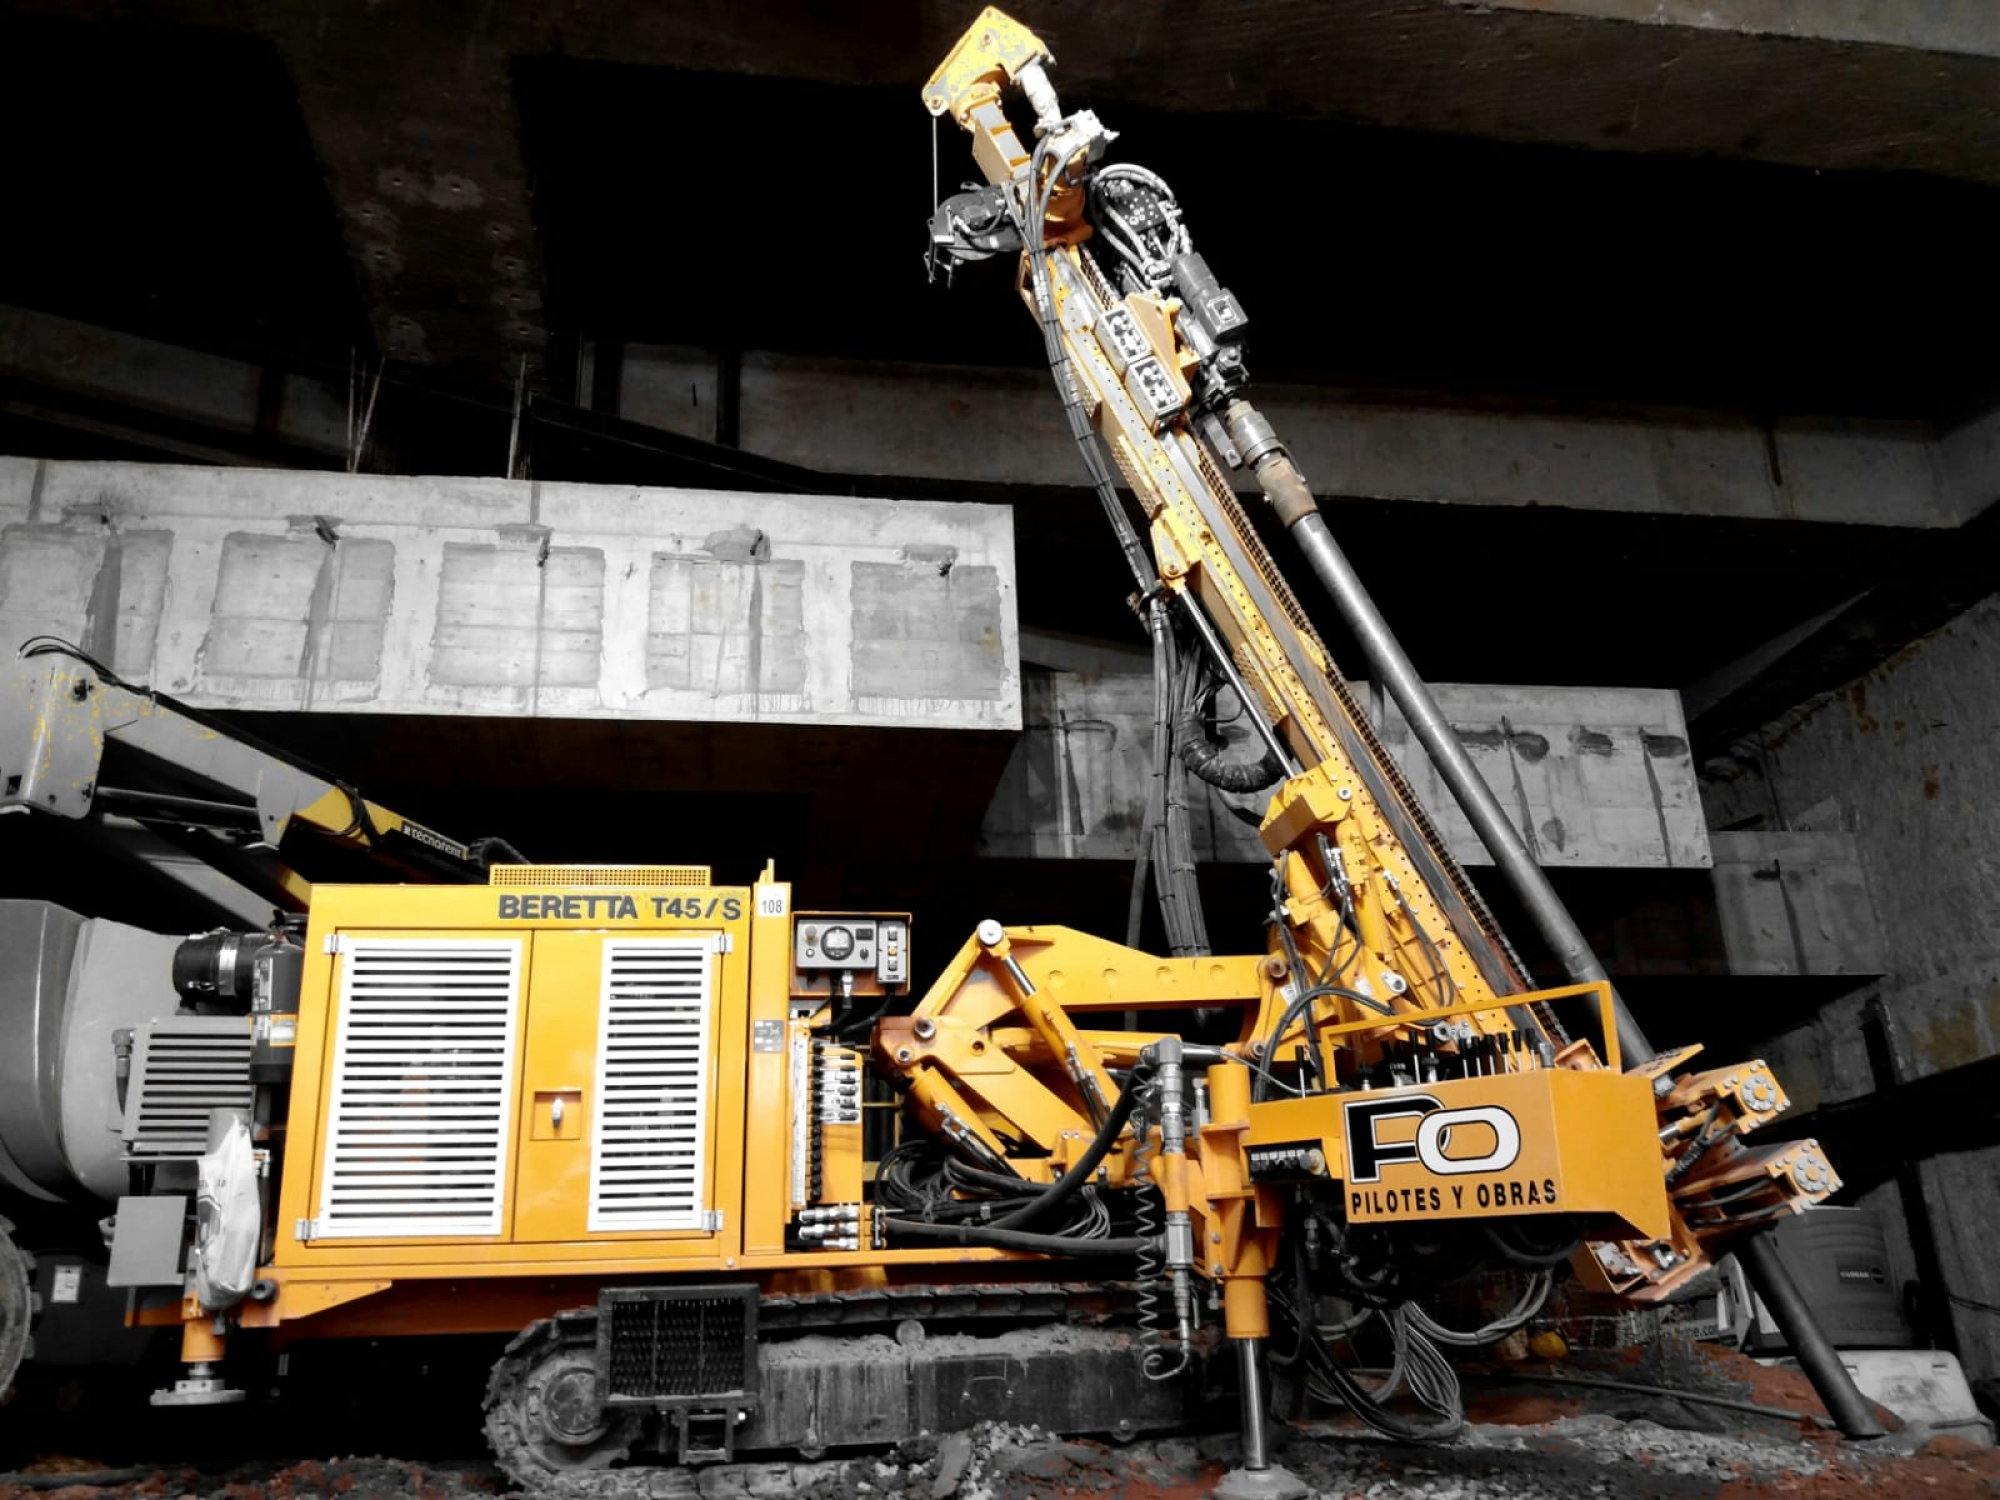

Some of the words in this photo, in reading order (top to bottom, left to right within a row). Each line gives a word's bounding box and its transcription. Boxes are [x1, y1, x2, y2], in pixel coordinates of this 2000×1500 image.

[498, 894, 639, 920] BERETTA
[650, 897, 741, 921] T45/S
[761, 899, 783, 914] 108
[1343, 1093, 1521, 1184] PO
[1351, 1187, 1441, 1215] PILOTES
[1452, 1185, 1464, 1209] Y
[1477, 1179, 1557, 1207] OBRAS
